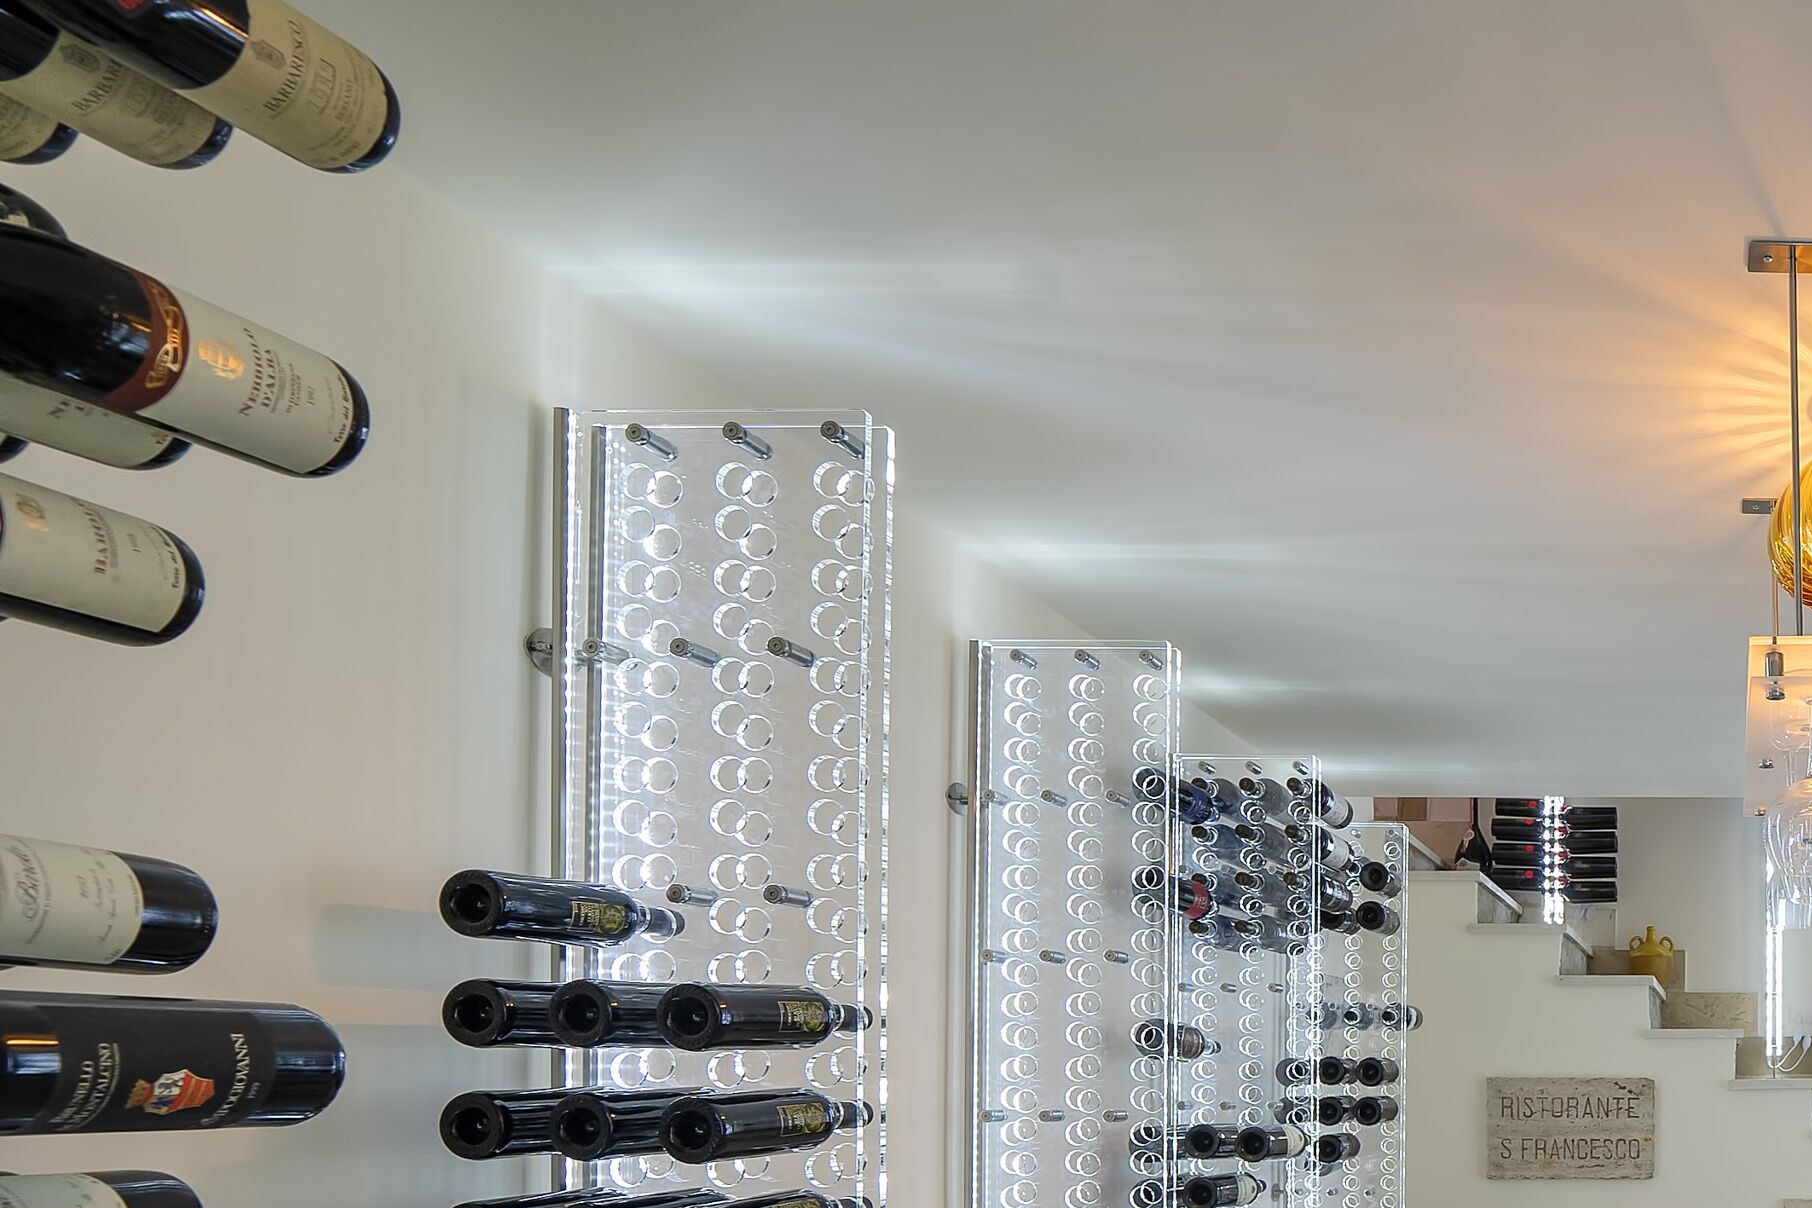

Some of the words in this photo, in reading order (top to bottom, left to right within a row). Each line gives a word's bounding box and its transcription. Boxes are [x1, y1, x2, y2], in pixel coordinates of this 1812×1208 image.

[1501, 1096, 1642, 1120] RISTORANTE
[1501, 1137, 1512, 1160] S
[1521, 1136, 1642, 1161] FRANCESCO
